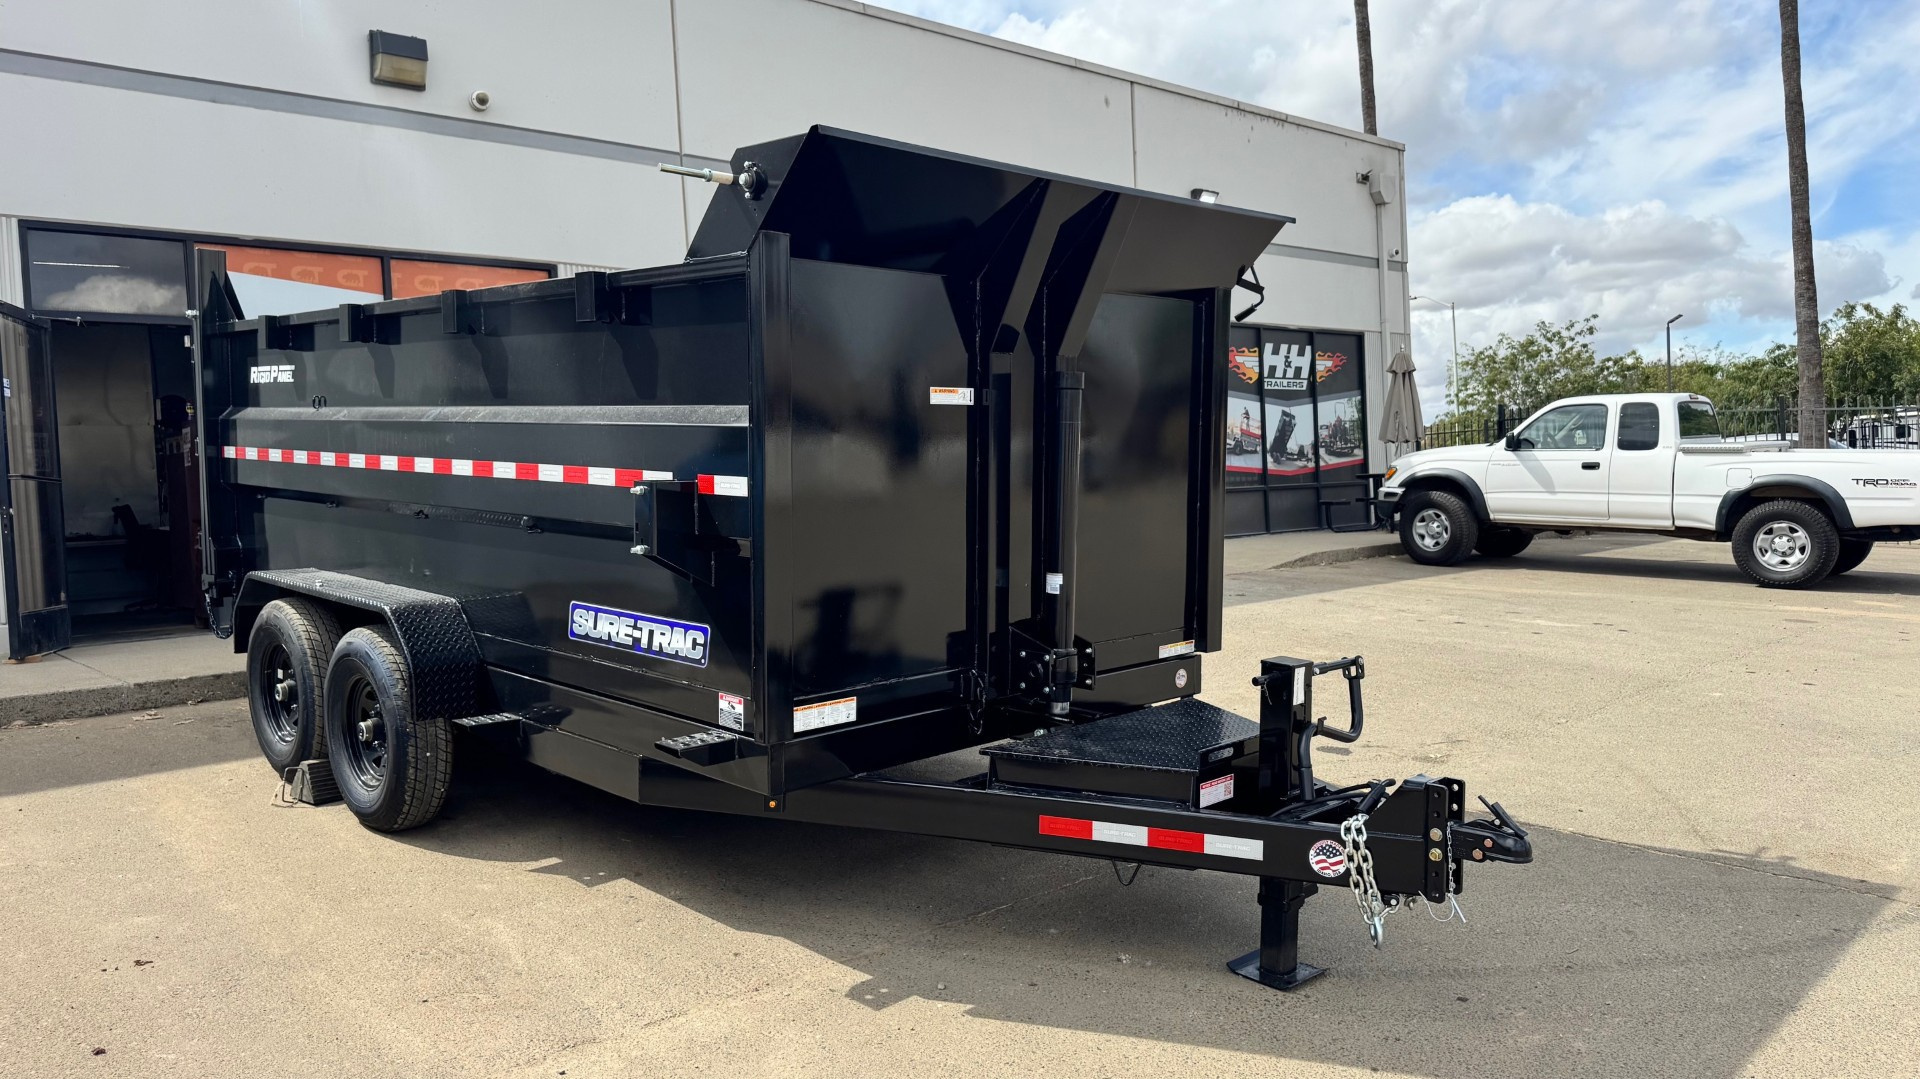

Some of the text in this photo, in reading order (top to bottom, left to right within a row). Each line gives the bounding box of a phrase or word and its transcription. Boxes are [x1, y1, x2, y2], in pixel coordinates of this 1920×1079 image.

[1263, 342, 1312, 379] H&H
[1264, 380, 1304, 389] RAILERS
[1851, 478, 1889, 488] TRD
[572, 608, 705, 661] SURE-TRAC
